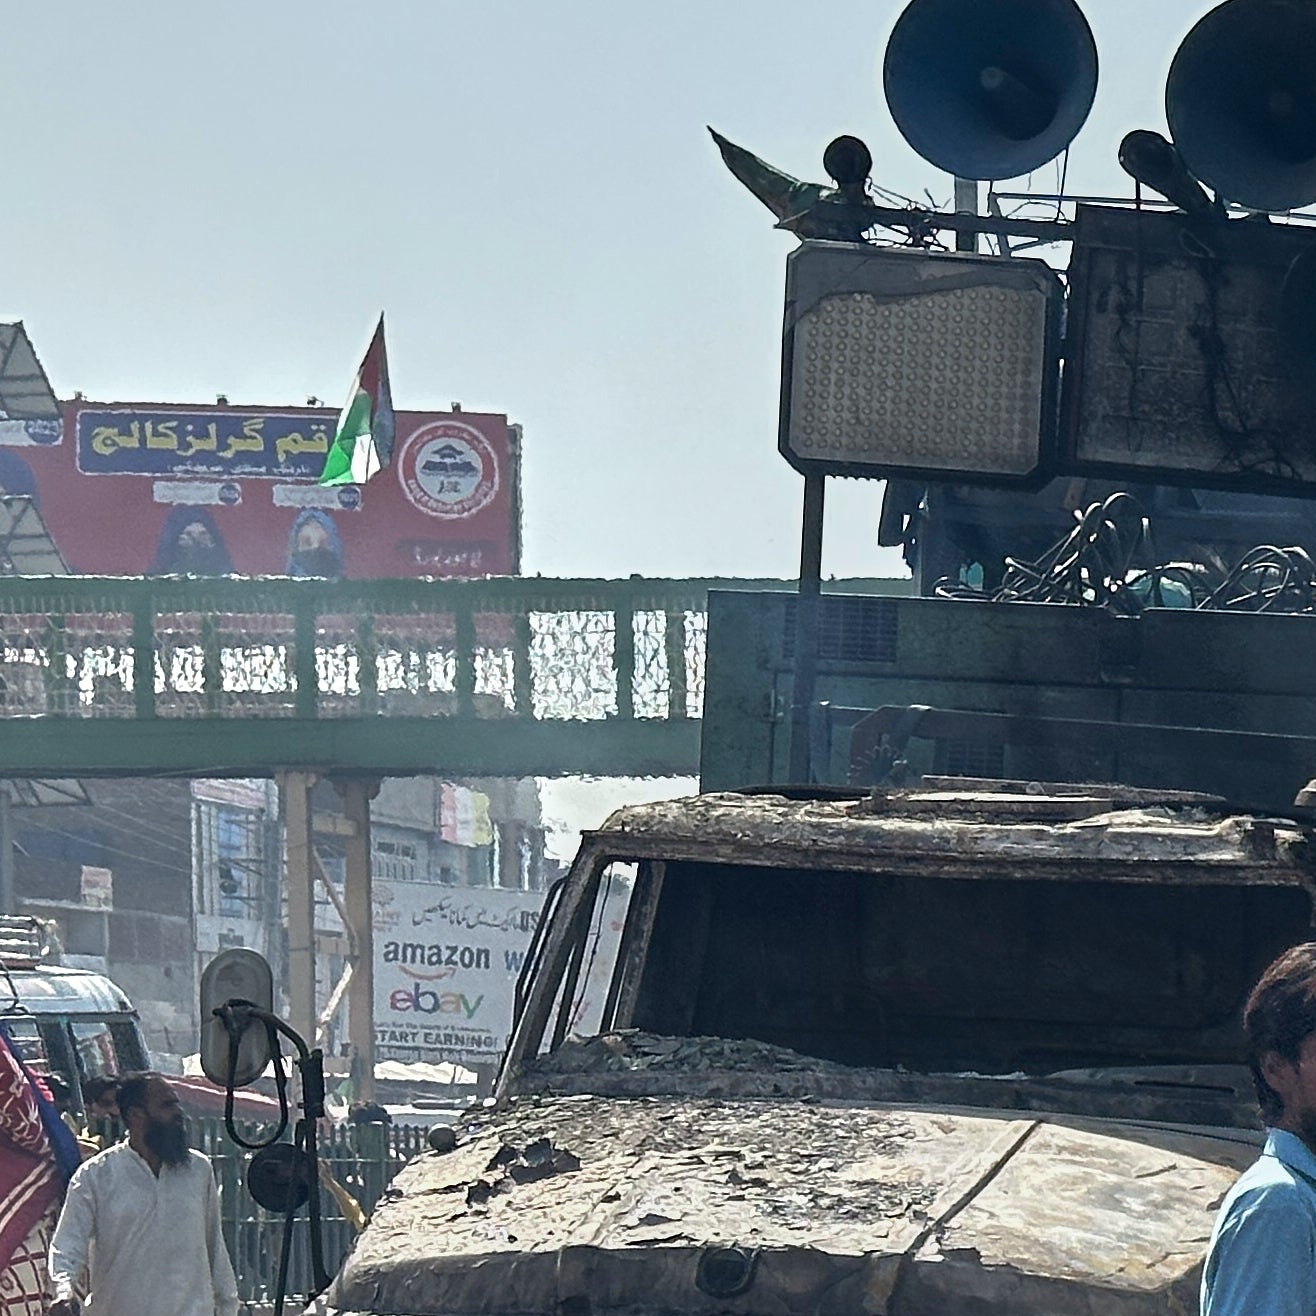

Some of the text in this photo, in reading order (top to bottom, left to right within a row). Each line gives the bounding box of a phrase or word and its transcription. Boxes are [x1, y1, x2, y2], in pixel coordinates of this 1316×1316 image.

[91, 419, 179, 456] کالج
[175, 418, 265, 459] گرلز
[383, 941, 490, 969] amazon
[389, 982, 484, 1019] ebay
